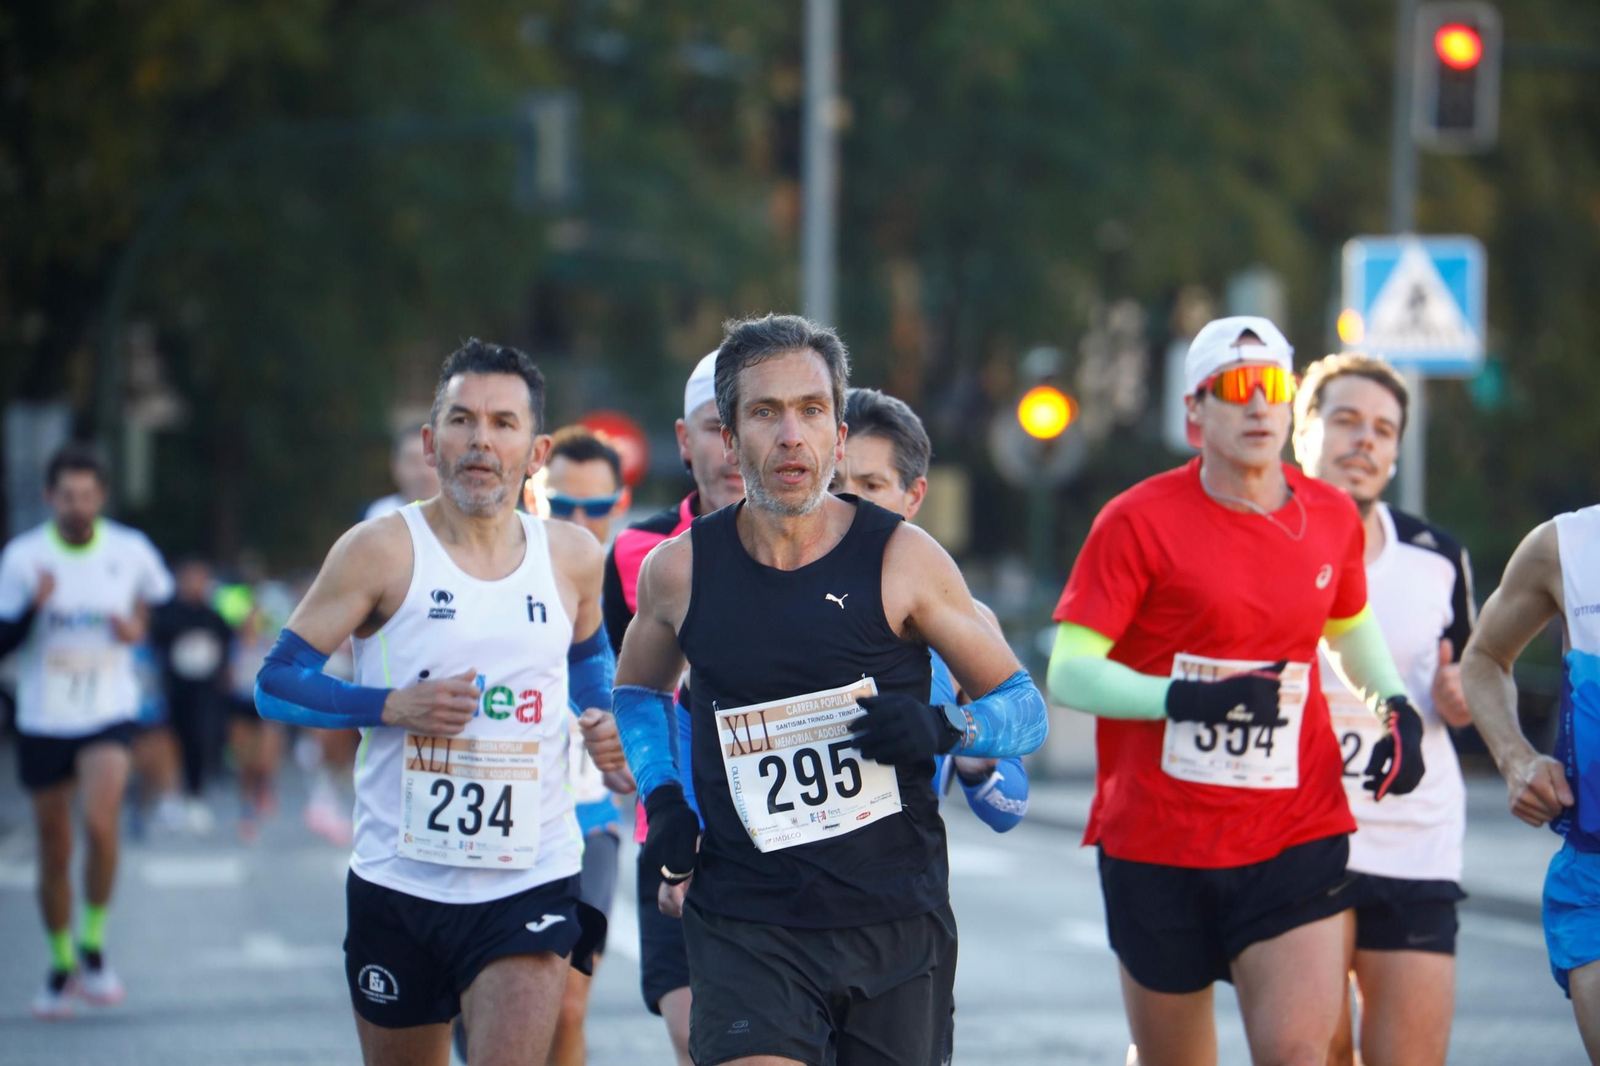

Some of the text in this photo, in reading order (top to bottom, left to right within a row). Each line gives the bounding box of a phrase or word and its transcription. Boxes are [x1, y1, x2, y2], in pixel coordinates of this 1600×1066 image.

[526, 595, 547, 623] in
[786, 693, 853, 715] CARRERA POPULAR
[775, 718, 806, 731] SANTISIMA
[808, 714, 834, 725] TRINIDAD
[838, 706, 866, 718] TRINITAR
[724, 710, 774, 757] XLI
[774, 732, 813, 748] MEMORIAL
[409, 735, 451, 774] XLI
[758, 740, 863, 815] 295
[427, 778, 514, 837] 234
[772, 832, 802, 844] IMDECO
